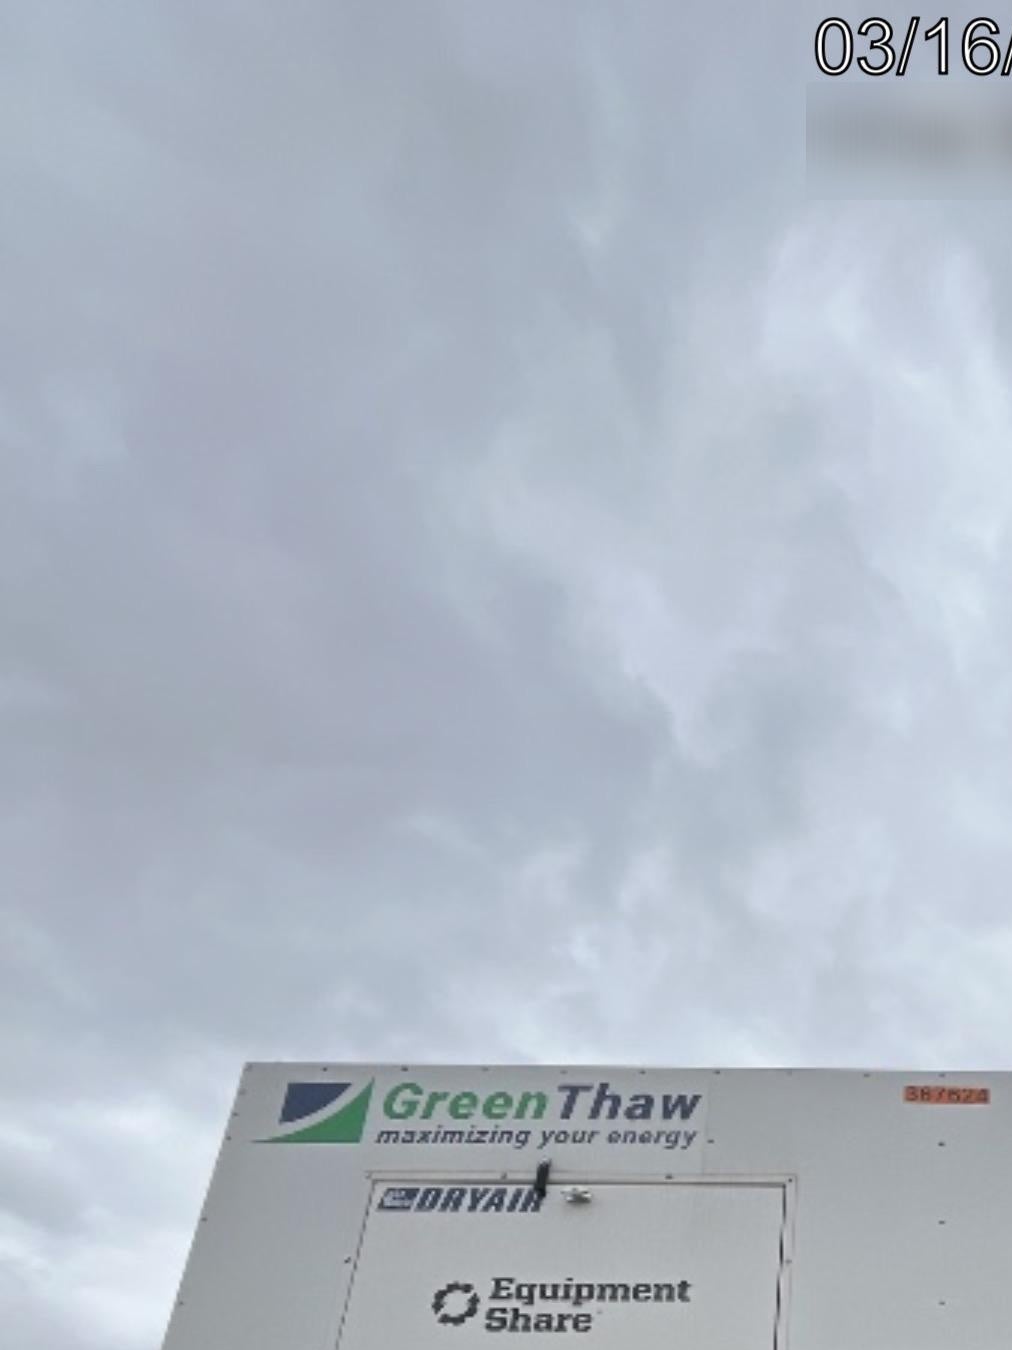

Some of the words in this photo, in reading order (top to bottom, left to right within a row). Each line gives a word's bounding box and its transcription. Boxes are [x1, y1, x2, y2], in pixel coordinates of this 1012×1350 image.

[375, 1124, 531, 1148] maximizing
[537, 1129, 599, 1149] your
[607, 1129, 697, 1149] energy
[488, 1276, 692, 1306] Equipment
[484, 1307, 592, 1333] Share
